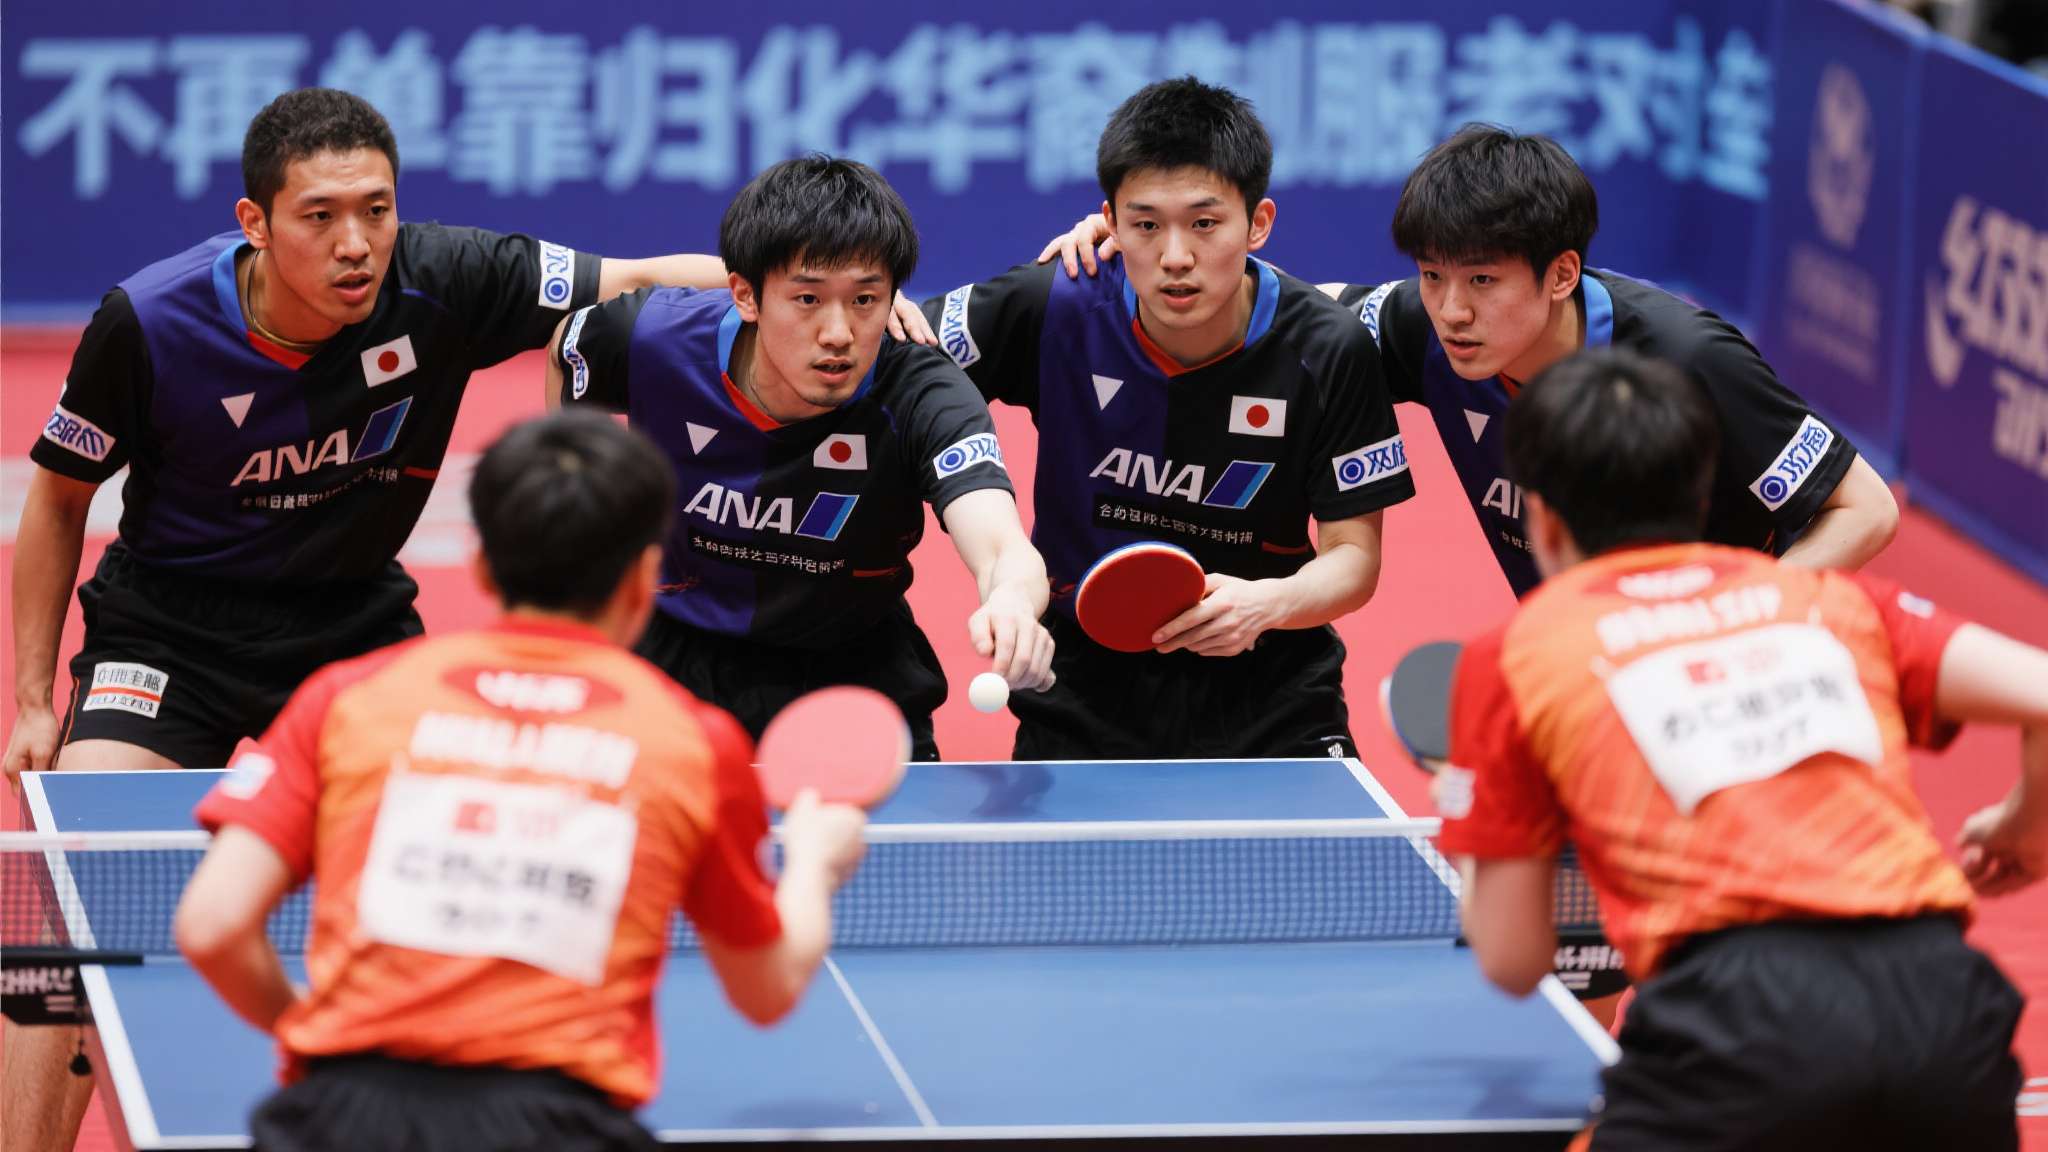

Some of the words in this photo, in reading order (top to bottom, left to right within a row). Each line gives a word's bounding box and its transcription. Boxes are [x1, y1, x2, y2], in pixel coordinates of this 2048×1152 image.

[230, 429, 349, 487] ANA
[1089, 447, 1206, 504] ANA
[683, 482, 793, 534] ANA
